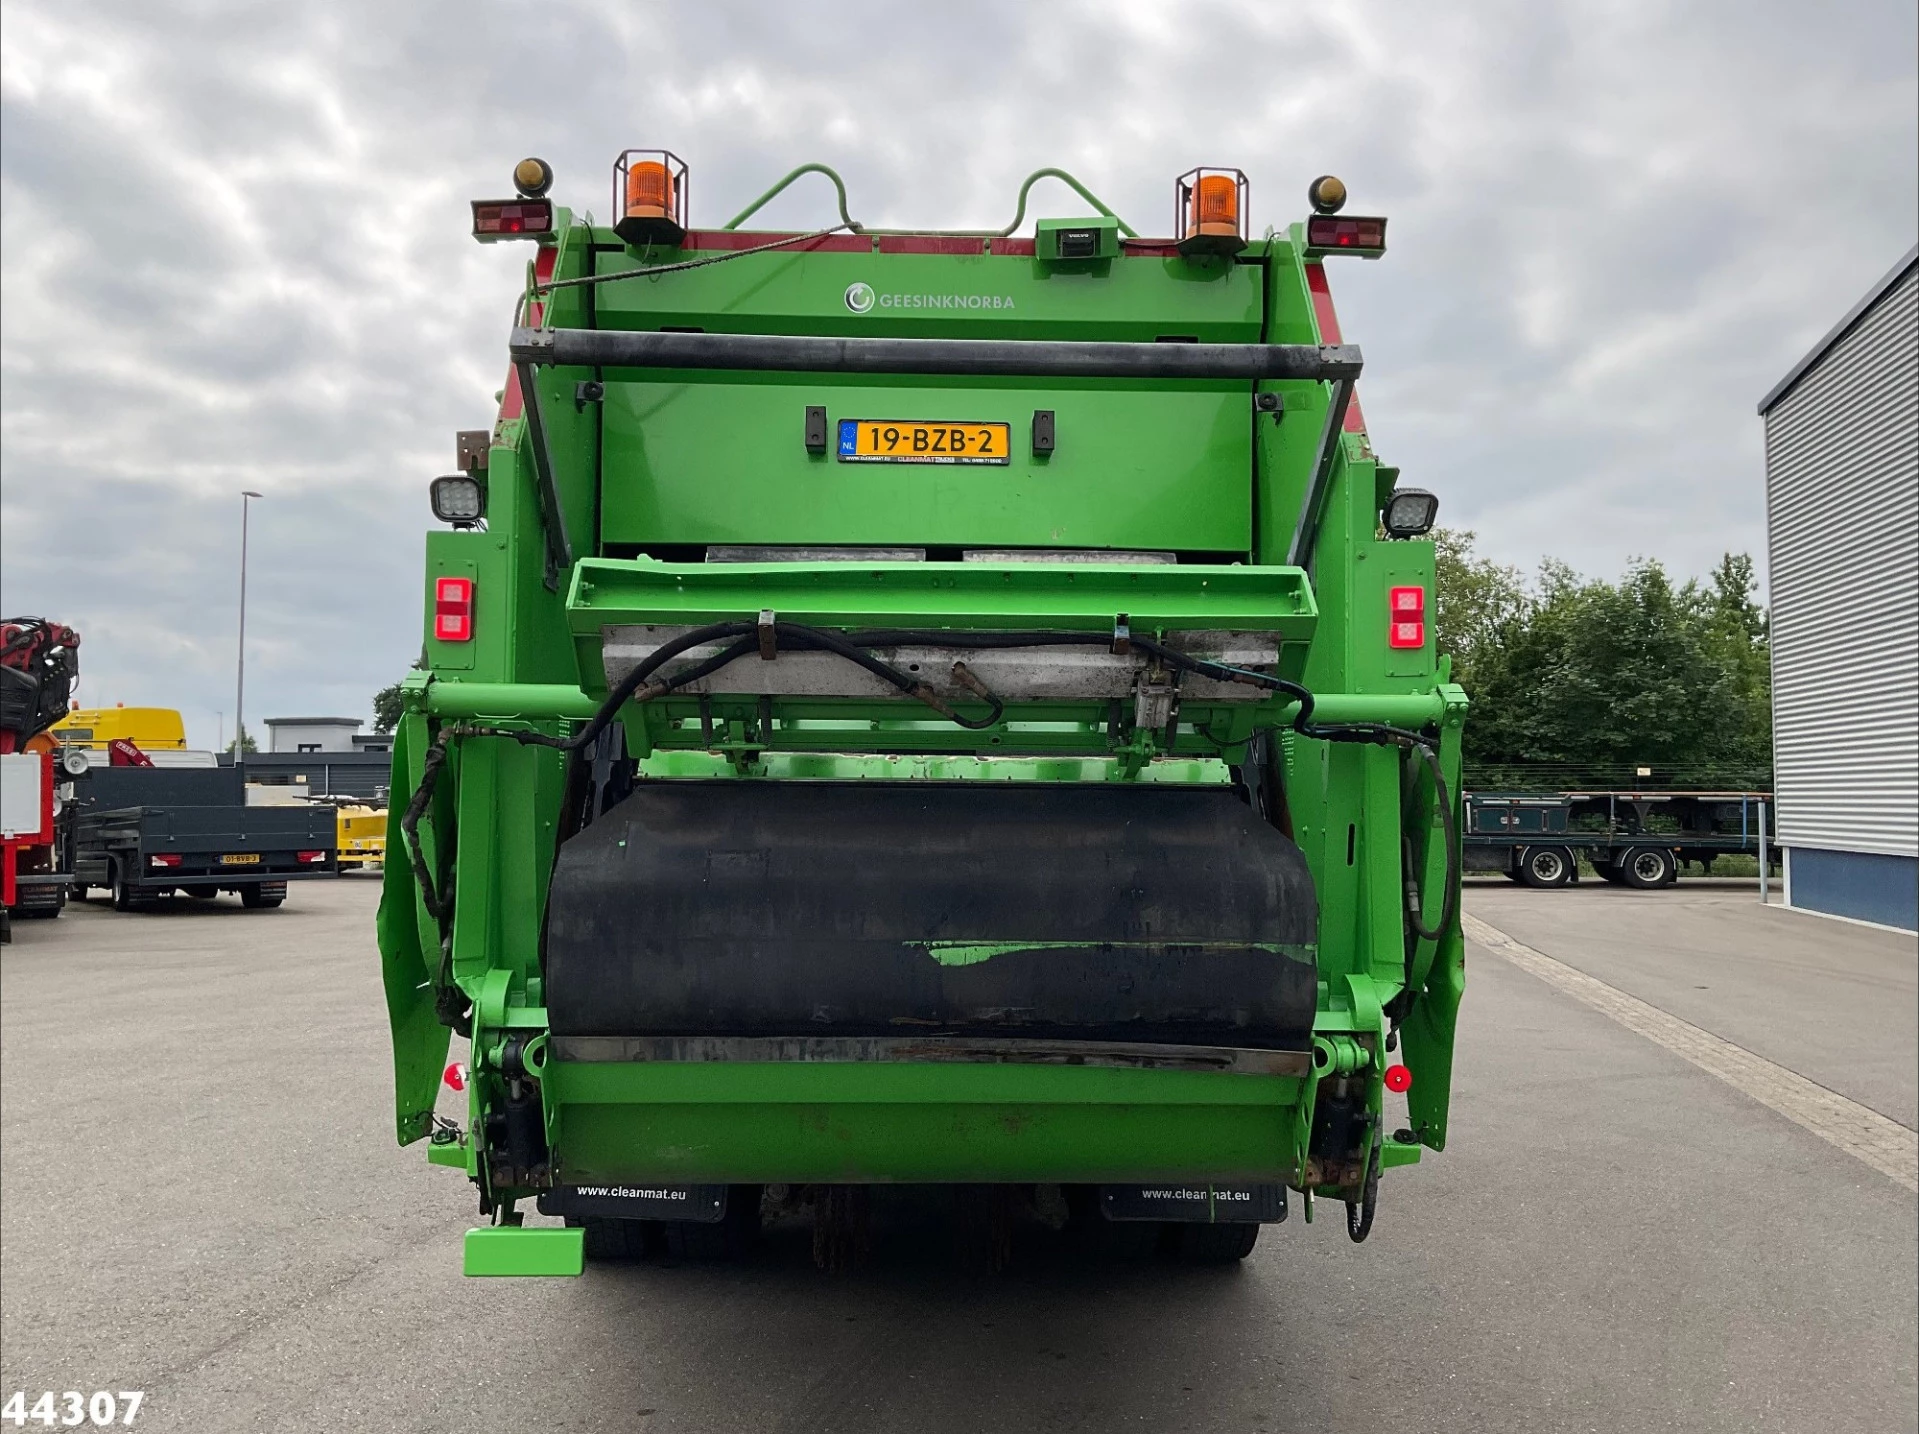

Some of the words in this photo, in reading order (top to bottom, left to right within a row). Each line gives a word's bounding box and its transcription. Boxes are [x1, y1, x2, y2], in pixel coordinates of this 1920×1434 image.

[880, 294, 1015, 309] GEESINKNORBA
[842, 442, 854, 450] NL
[871, 427, 993, 453] 19-BZB-2
[577, 1186, 686, 1200] www.cleanmat.eu
